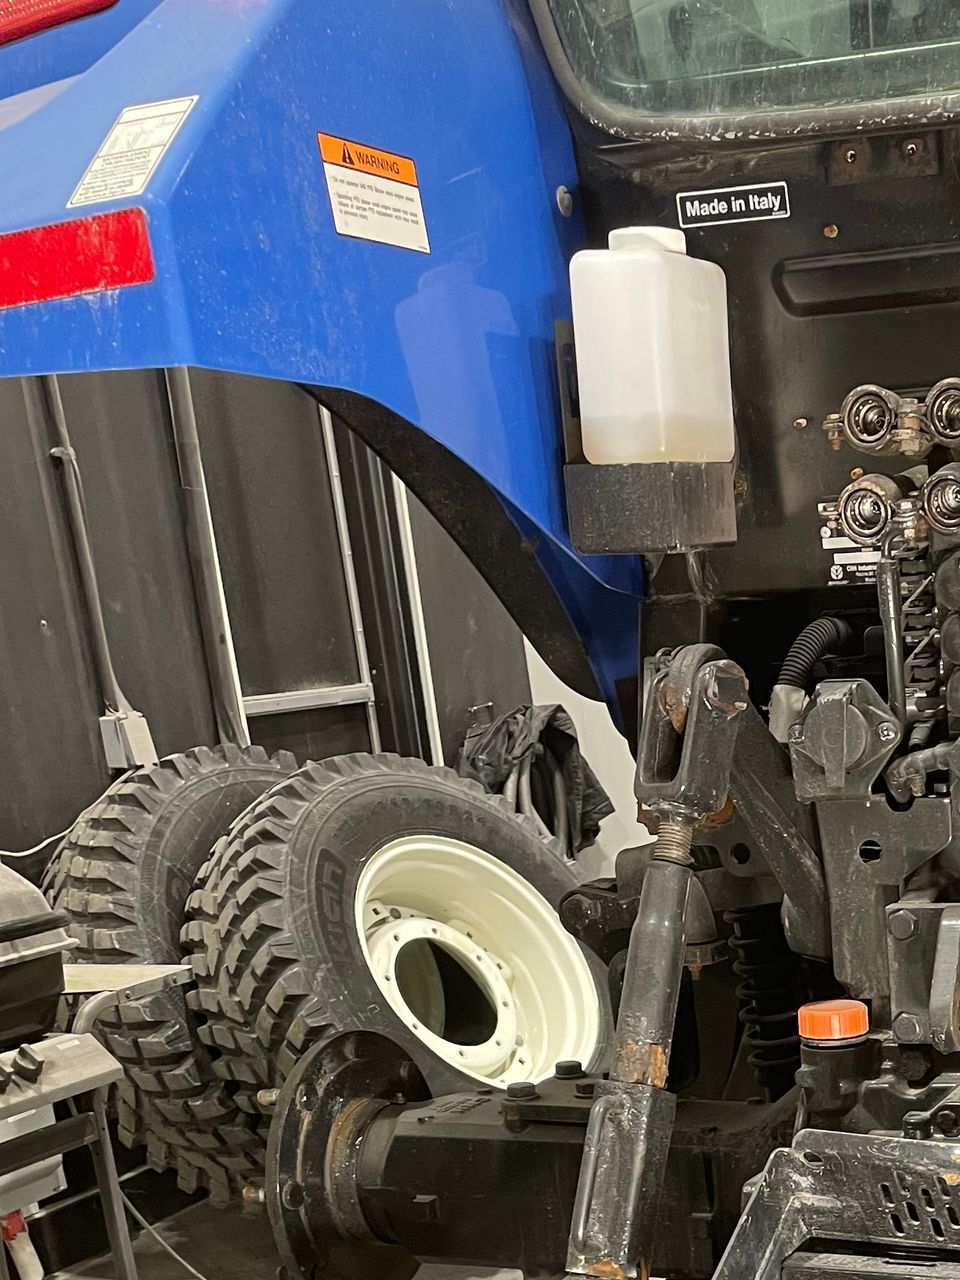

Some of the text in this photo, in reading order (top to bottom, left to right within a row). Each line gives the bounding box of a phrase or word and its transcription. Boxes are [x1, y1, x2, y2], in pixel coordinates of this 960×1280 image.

[355, 150, 400, 174] WARNING
[685, 192, 781, 217] Made in Italy
